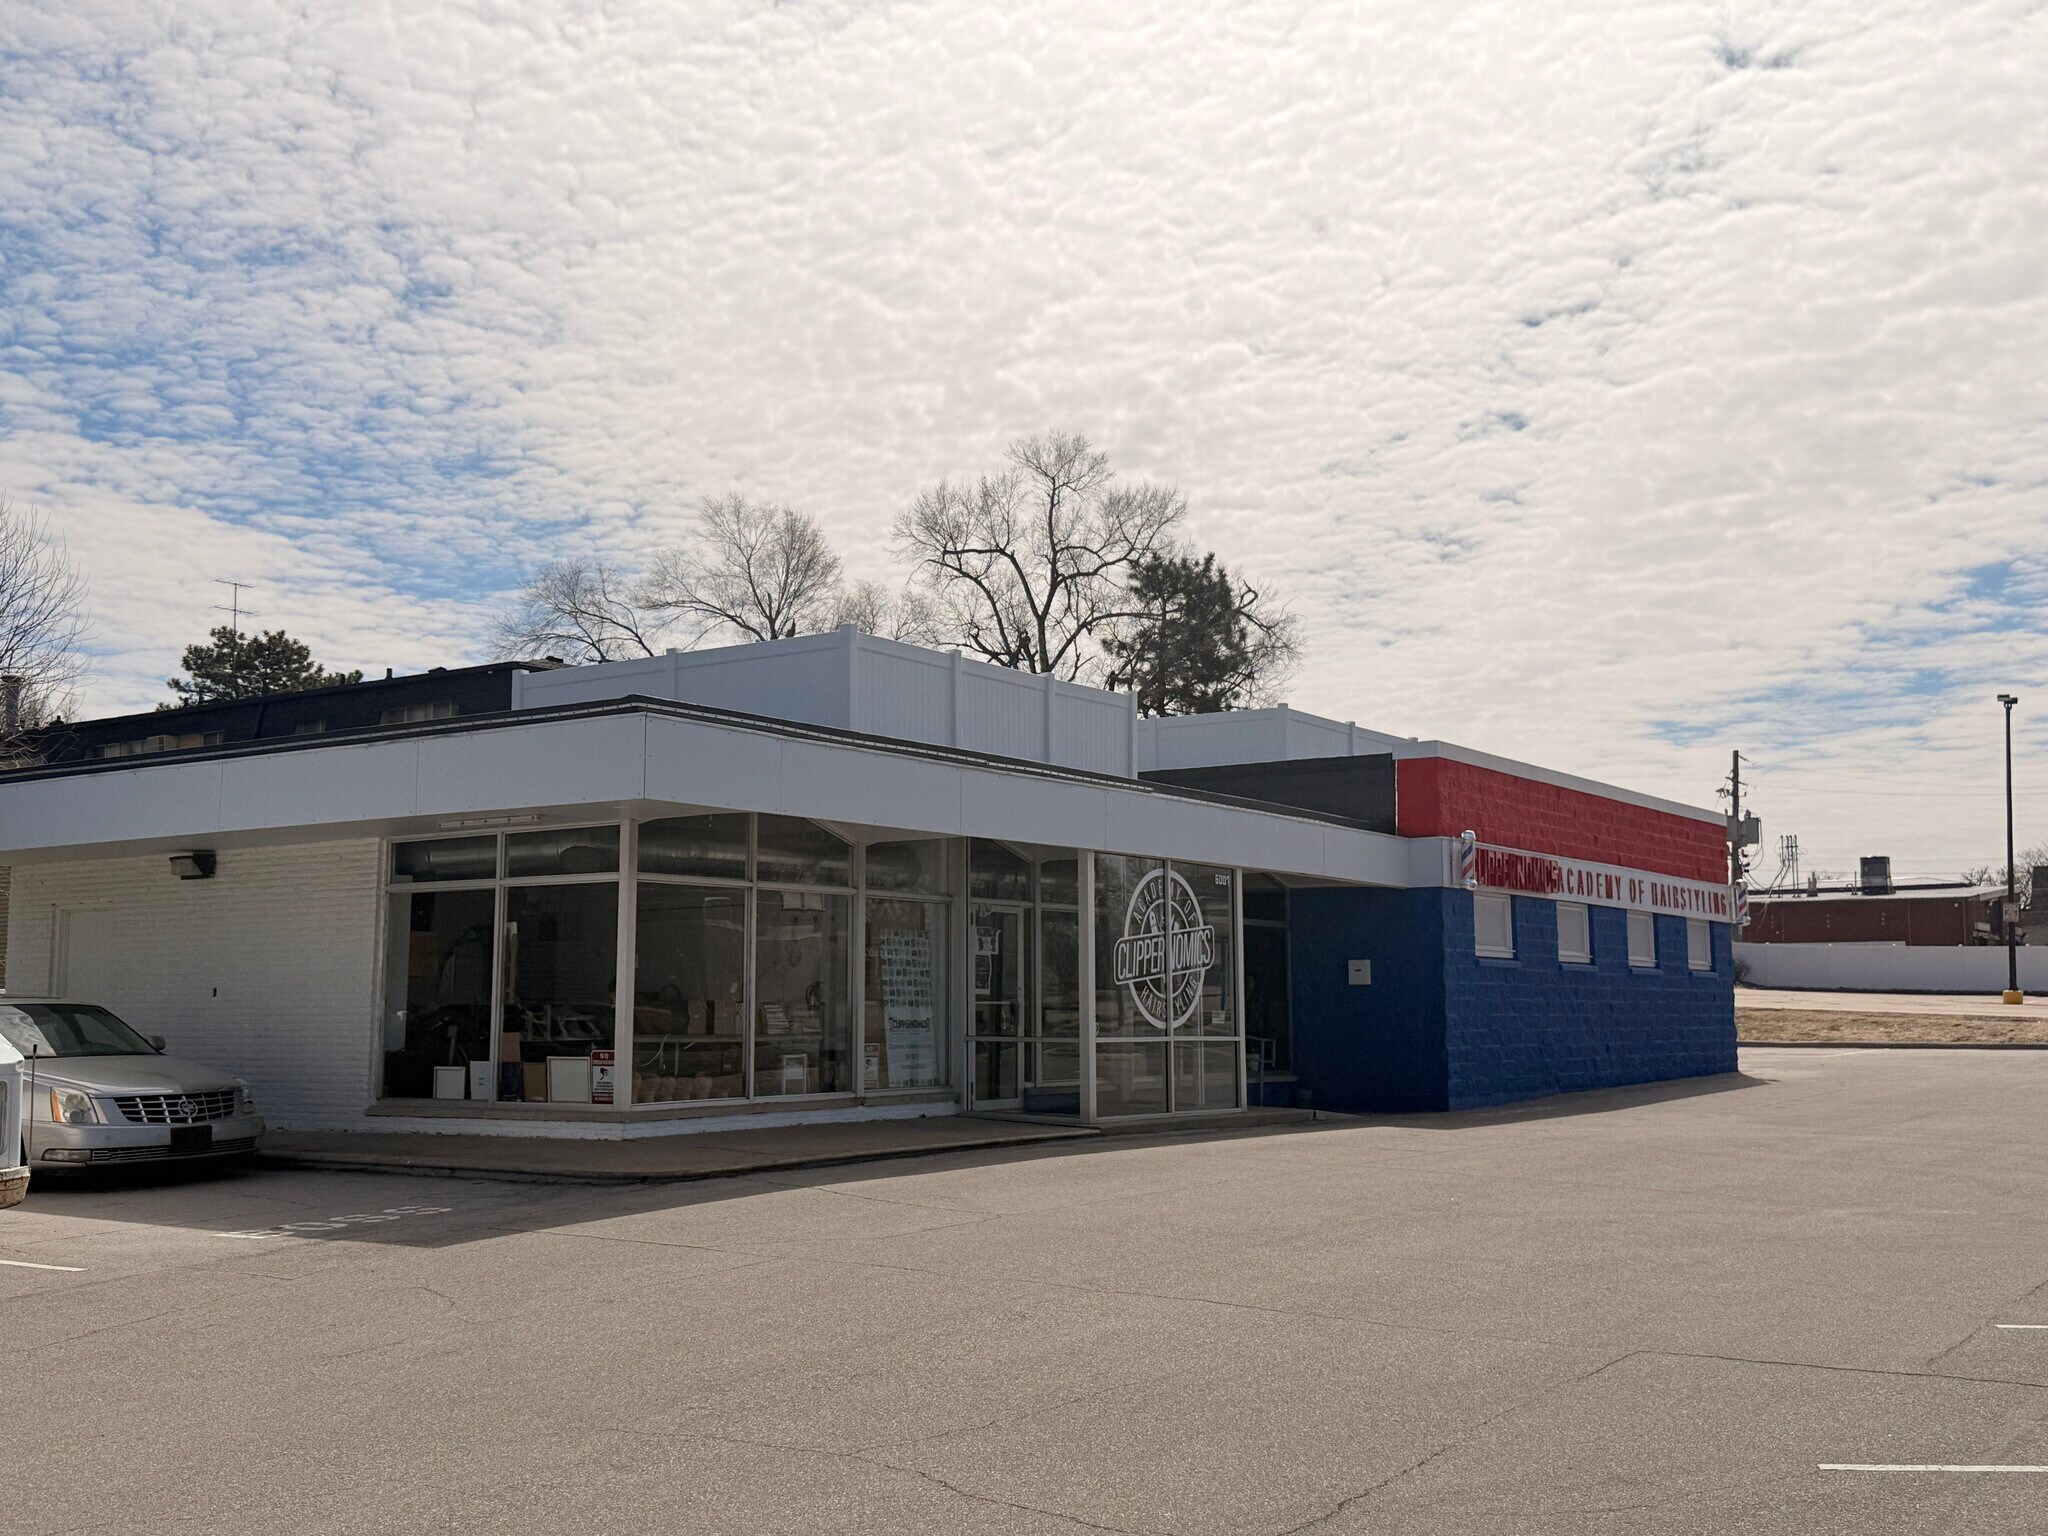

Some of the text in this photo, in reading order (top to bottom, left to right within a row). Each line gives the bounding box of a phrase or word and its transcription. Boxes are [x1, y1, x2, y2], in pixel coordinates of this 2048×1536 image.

[1556, 866, 1621, 901] ACADEMY
[1629, 878, 1645, 904] OF
[1651, 881, 1727, 916] HAIRSTYLING
[1184, 900, 1197, 922] OF
[599, 1052, 609, 1060] NO
